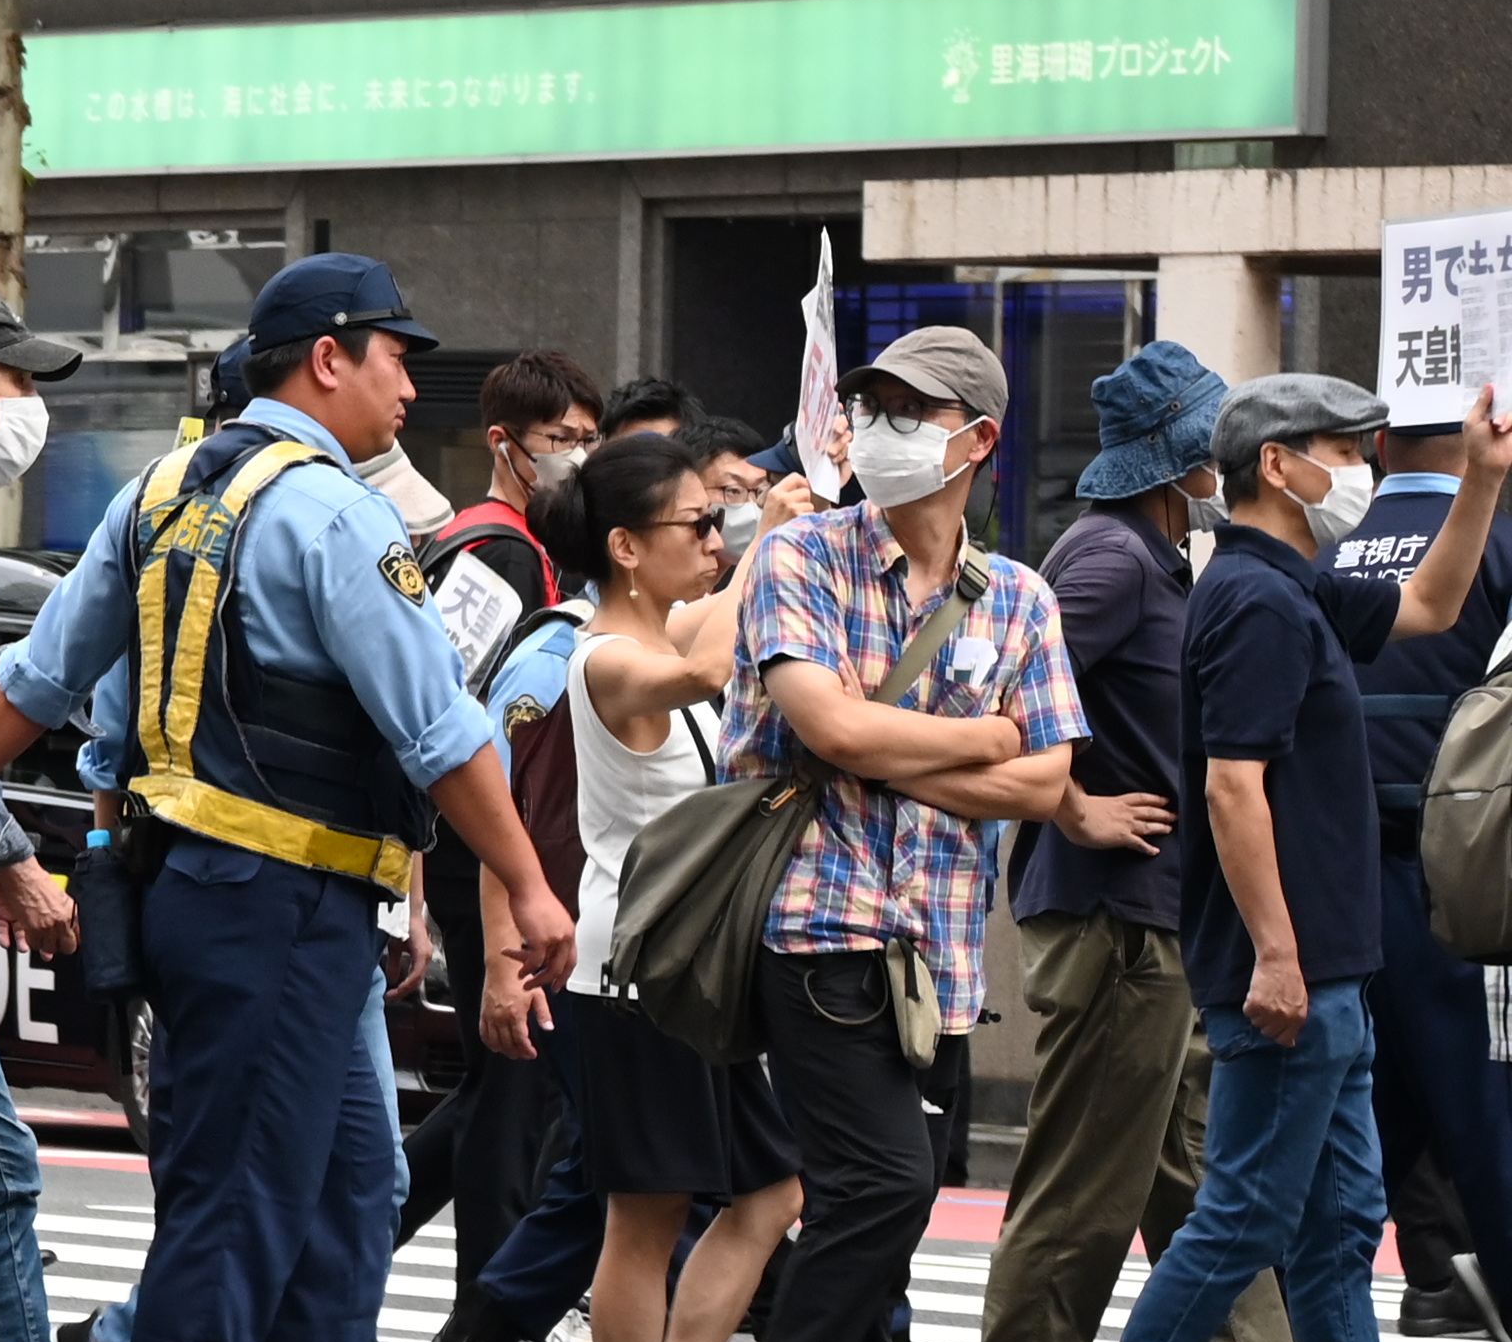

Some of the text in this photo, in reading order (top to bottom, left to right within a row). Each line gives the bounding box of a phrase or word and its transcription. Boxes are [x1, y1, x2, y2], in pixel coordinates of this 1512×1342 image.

[989, 35, 1232, 85] 里海珊瑚プロジェクト
[1333, 534, 1429, 569] 警視庁
